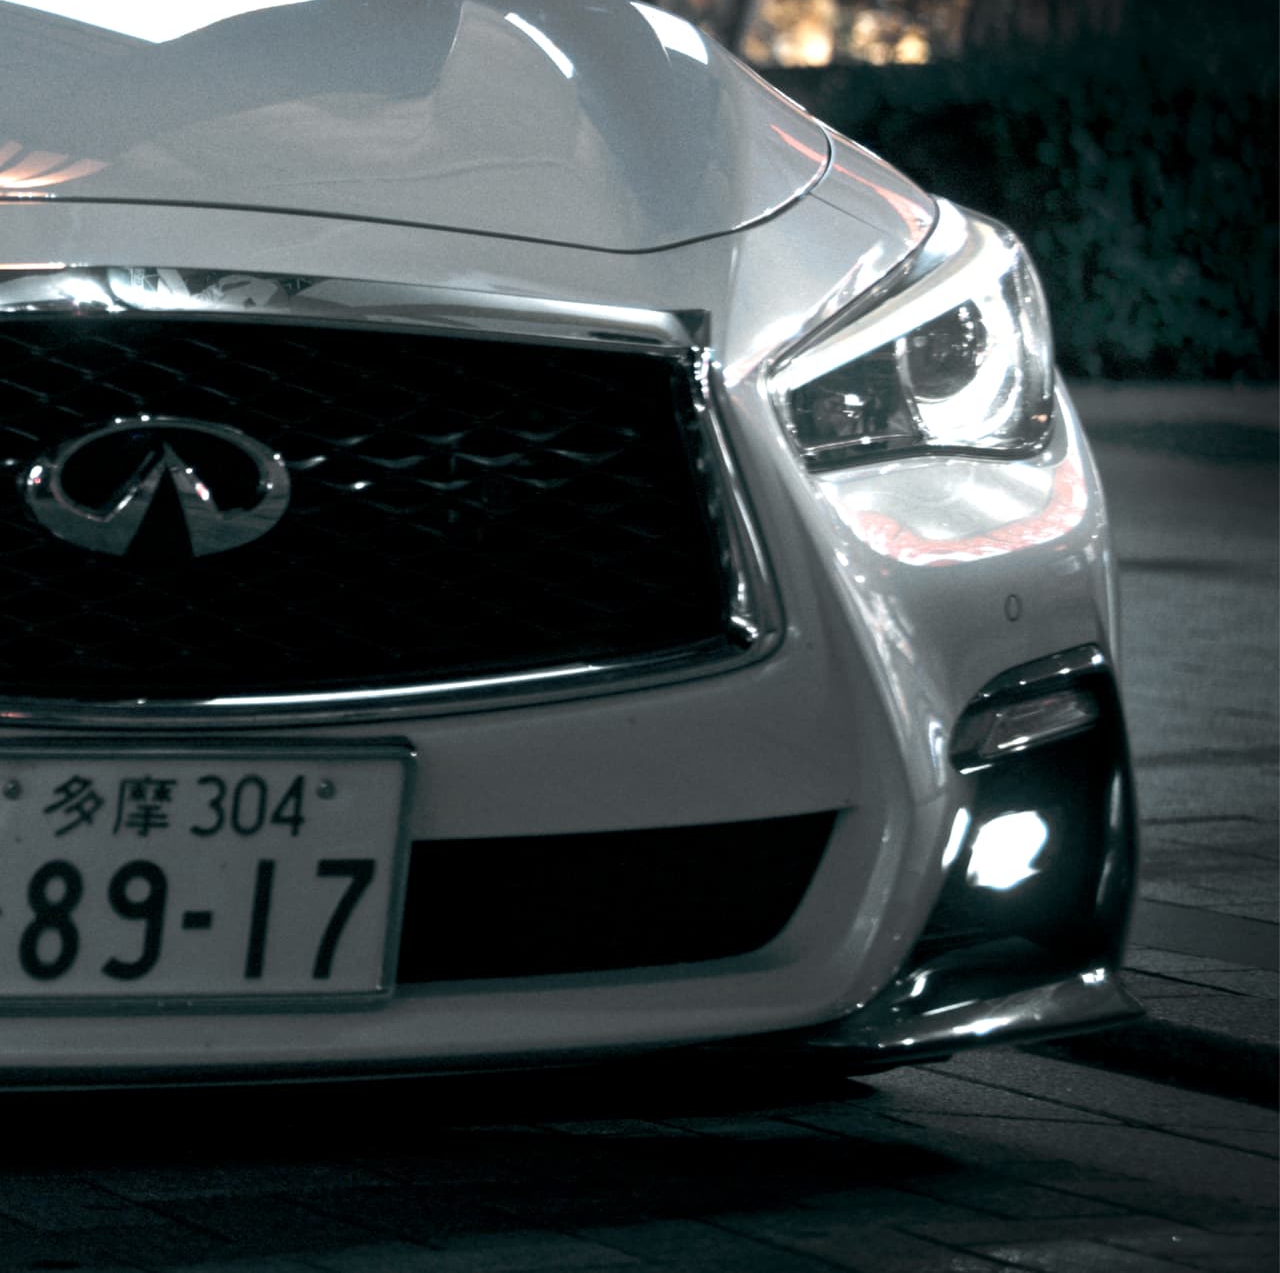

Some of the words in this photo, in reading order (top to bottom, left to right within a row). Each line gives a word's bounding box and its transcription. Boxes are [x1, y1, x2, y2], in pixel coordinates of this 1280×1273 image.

[43, 774, 178, 839] 多摩
[190, 774, 307, 838] 304
[19, 859, 377, 982] 89-17
